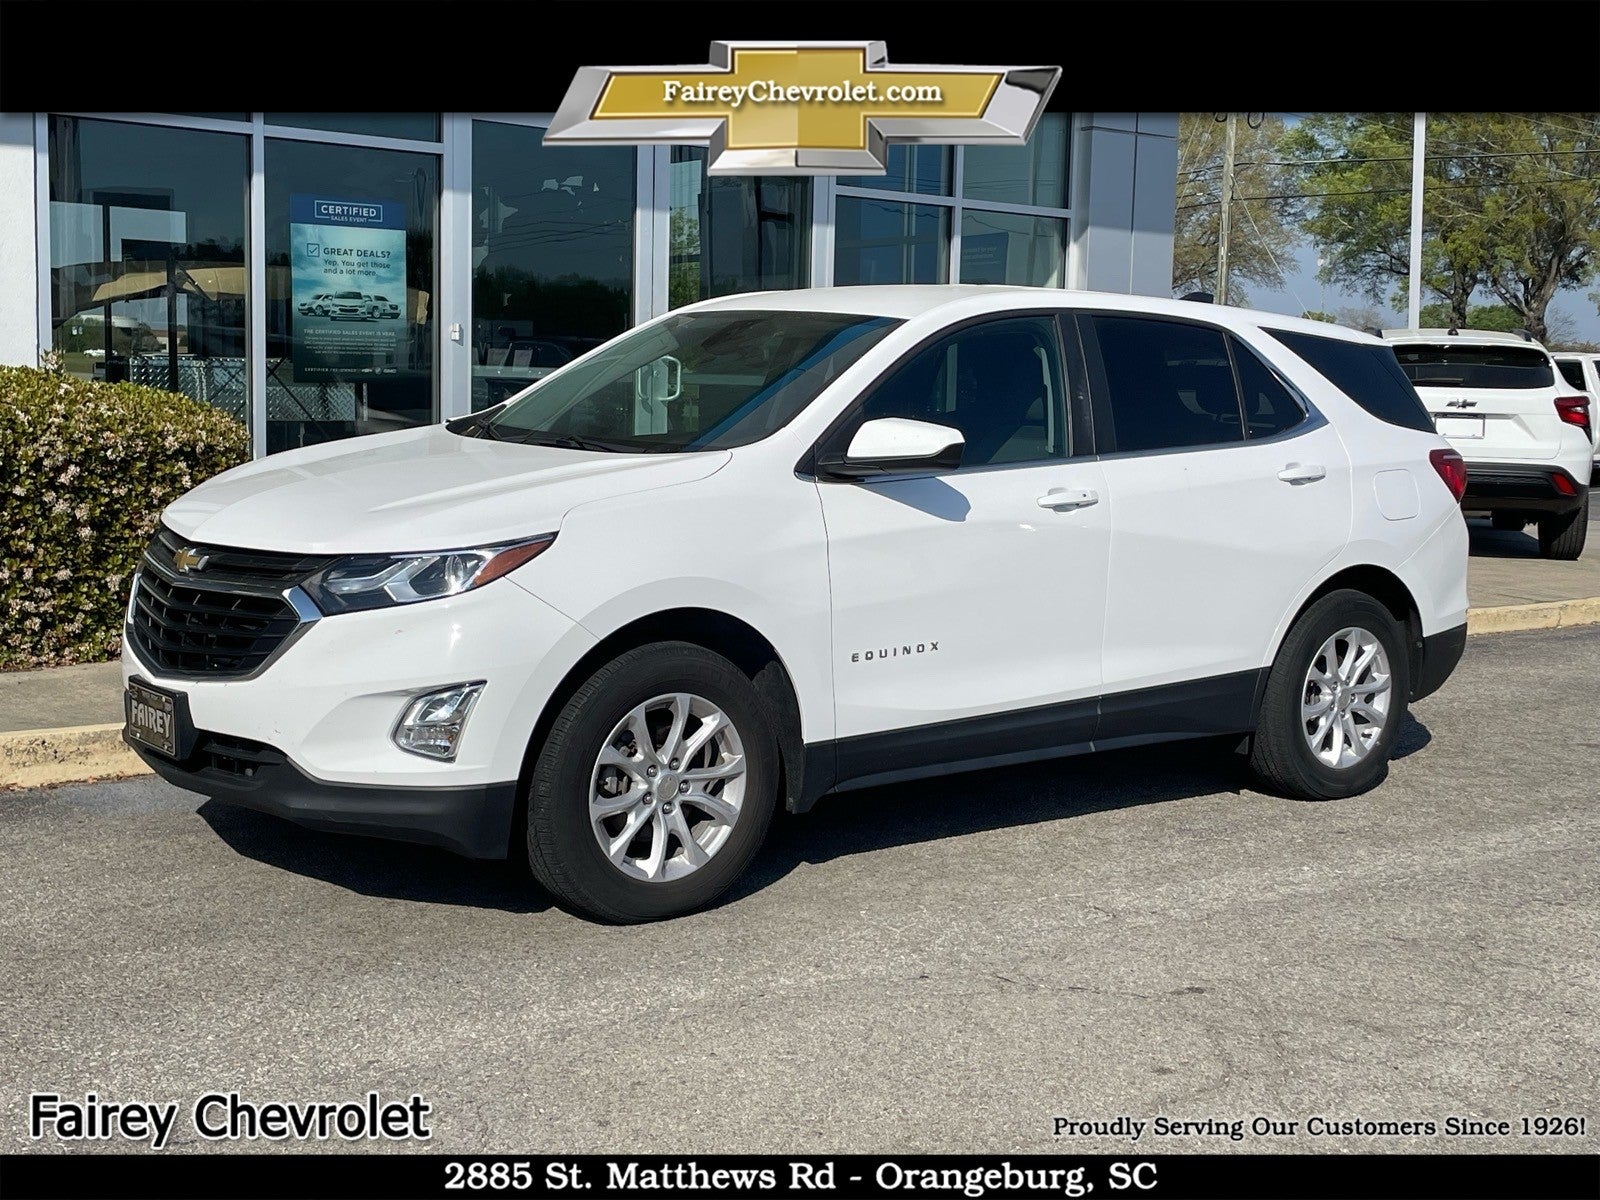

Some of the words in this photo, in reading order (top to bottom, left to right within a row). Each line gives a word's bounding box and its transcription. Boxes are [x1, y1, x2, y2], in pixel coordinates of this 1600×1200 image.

[321, 204, 377, 217] CERTIFIED
[323, 247, 353, 256] GREAT
[356, 249, 391, 258] DEALS?
[323, 259, 339, 267] Yep.
[356, 261, 369, 269] get
[370, 261, 391, 269] those
[851, 641, 938, 662] EQUINOX
[131, 700, 171, 738] FAIREY
